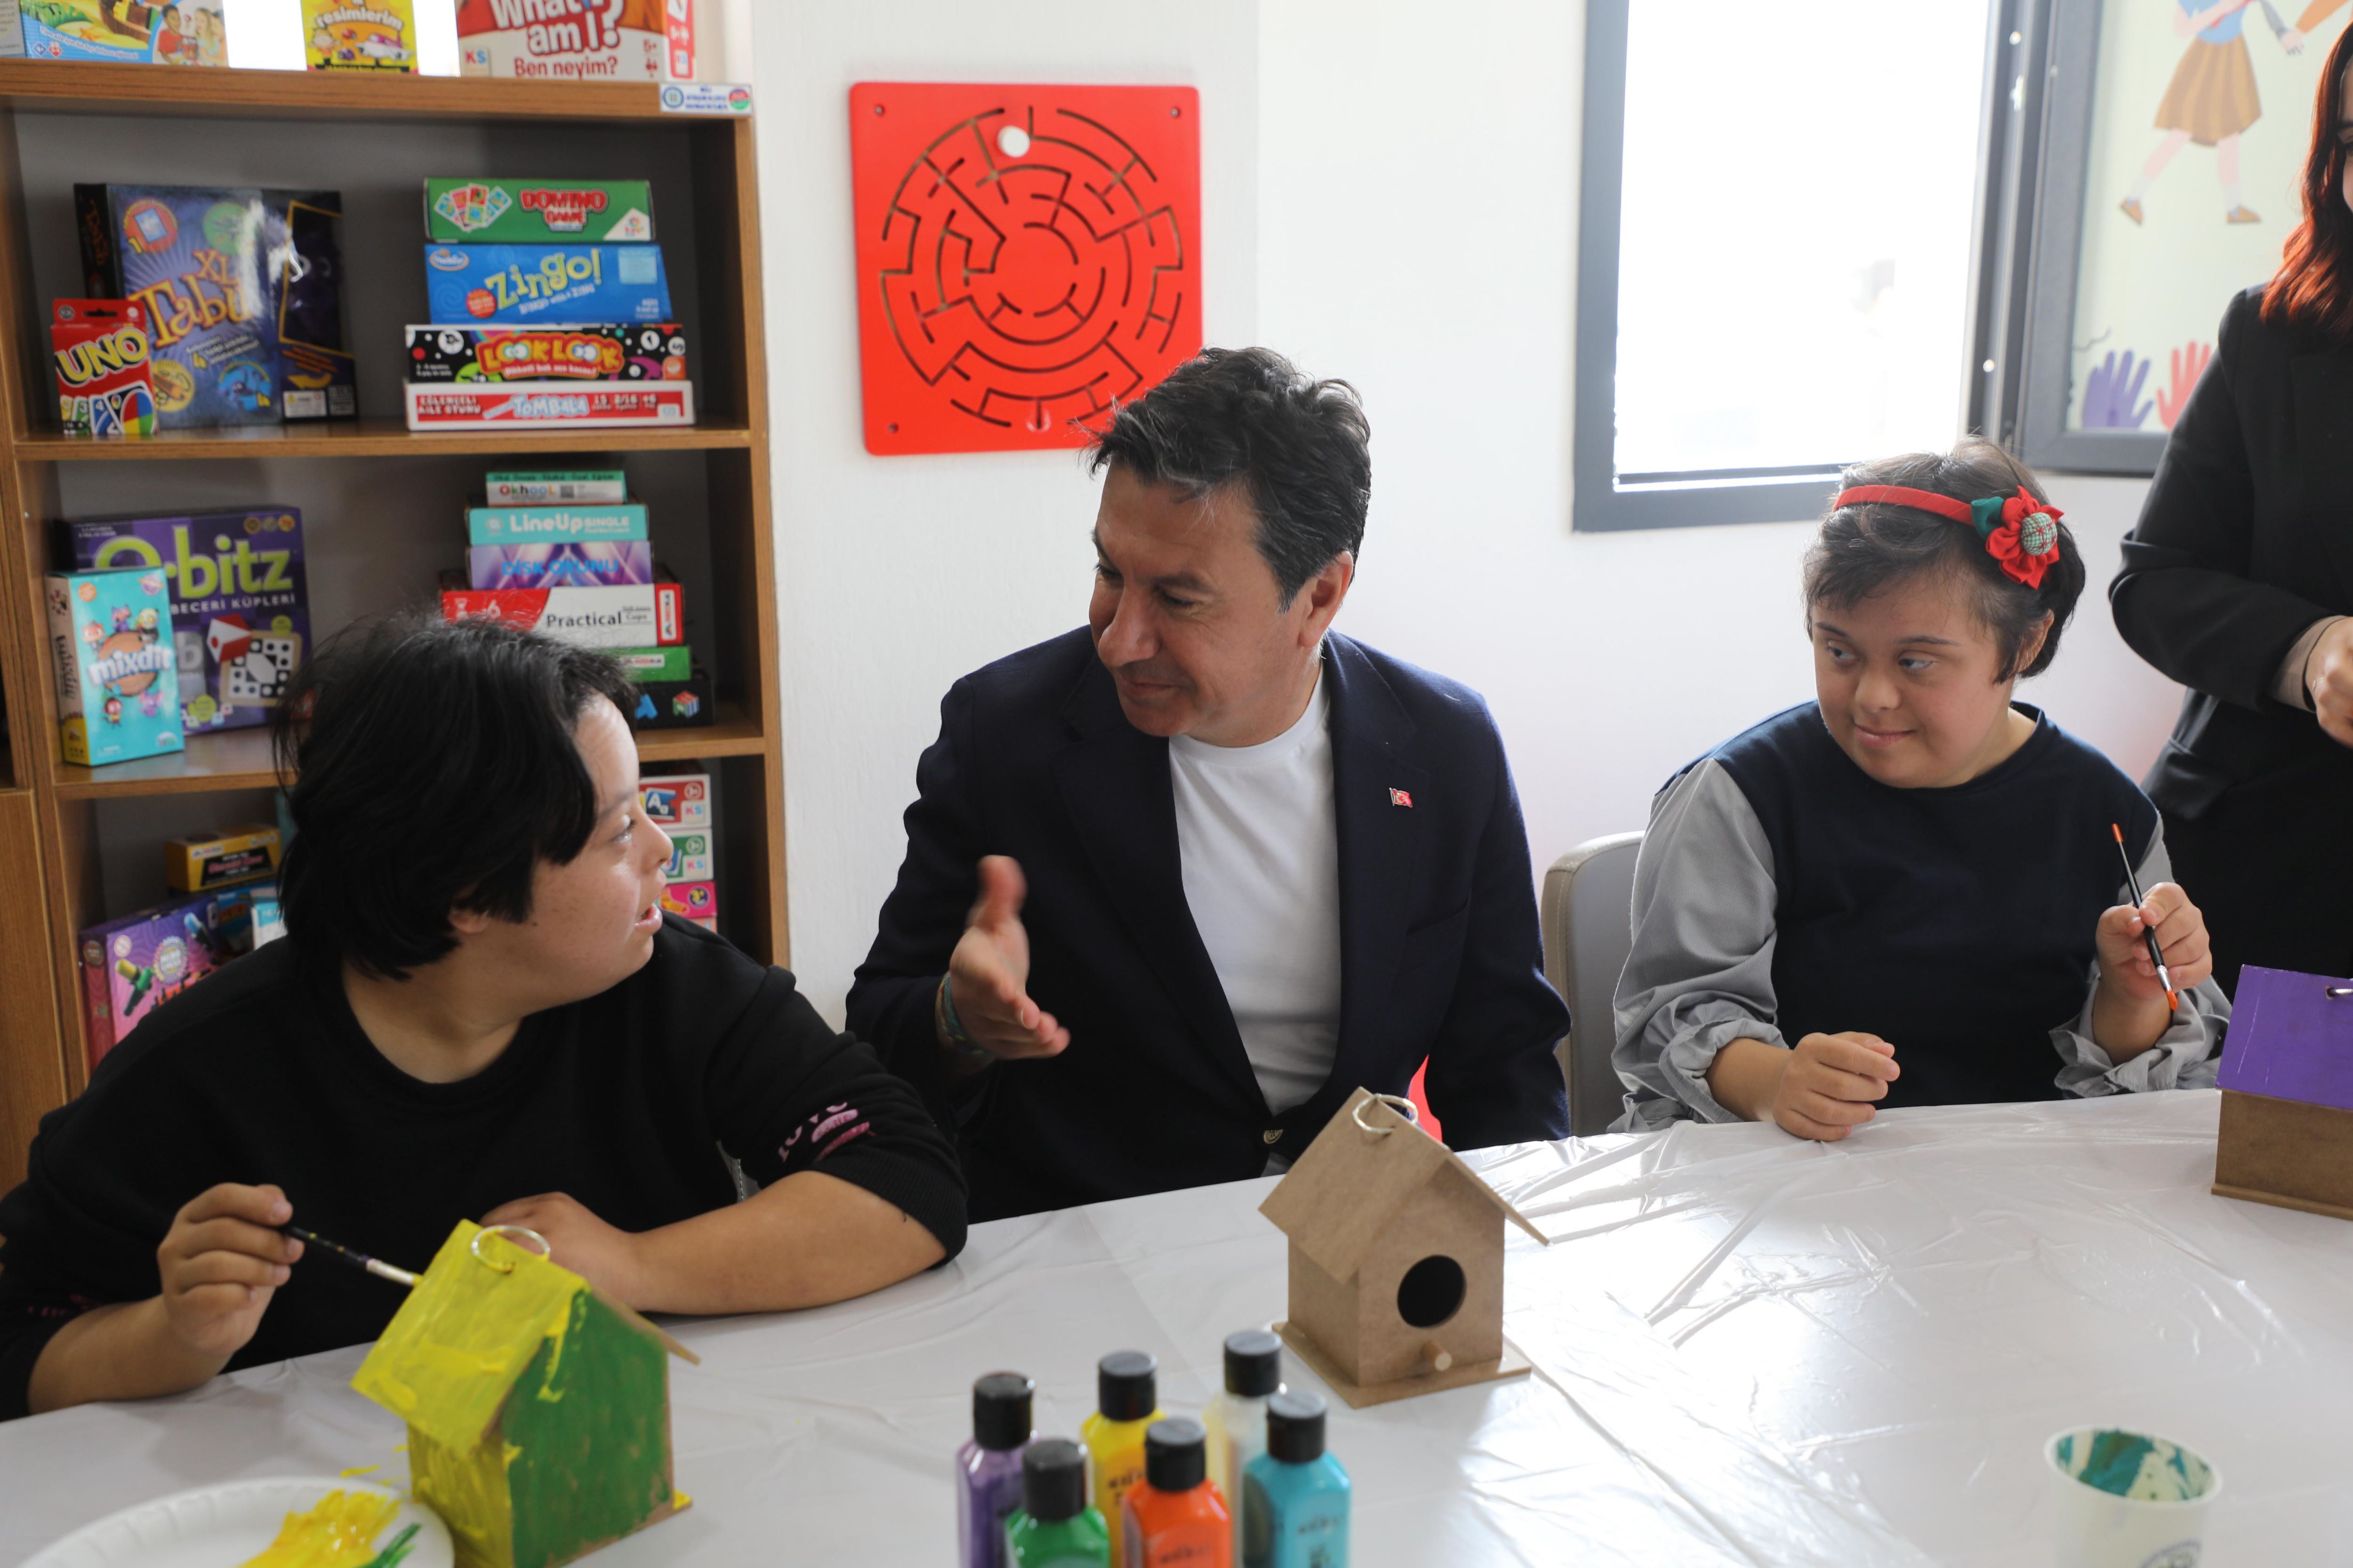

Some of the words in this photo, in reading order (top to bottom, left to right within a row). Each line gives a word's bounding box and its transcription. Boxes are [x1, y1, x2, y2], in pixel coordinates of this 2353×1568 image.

[528, 24, 584, 55] am
[514, 57, 548, 76] Ben
[553, 55, 618, 80] neyim?
[521, 189, 608, 211] DOMINO
[483, 248, 602, 311] Zingo!
[53, 328, 149, 386] UNO
[509, 513, 583, 534] LineUp
[549, 559, 619, 576] OYUNU
[233, 593, 296, 609] KÜPLERİ
[546, 611, 622, 627] Practical
